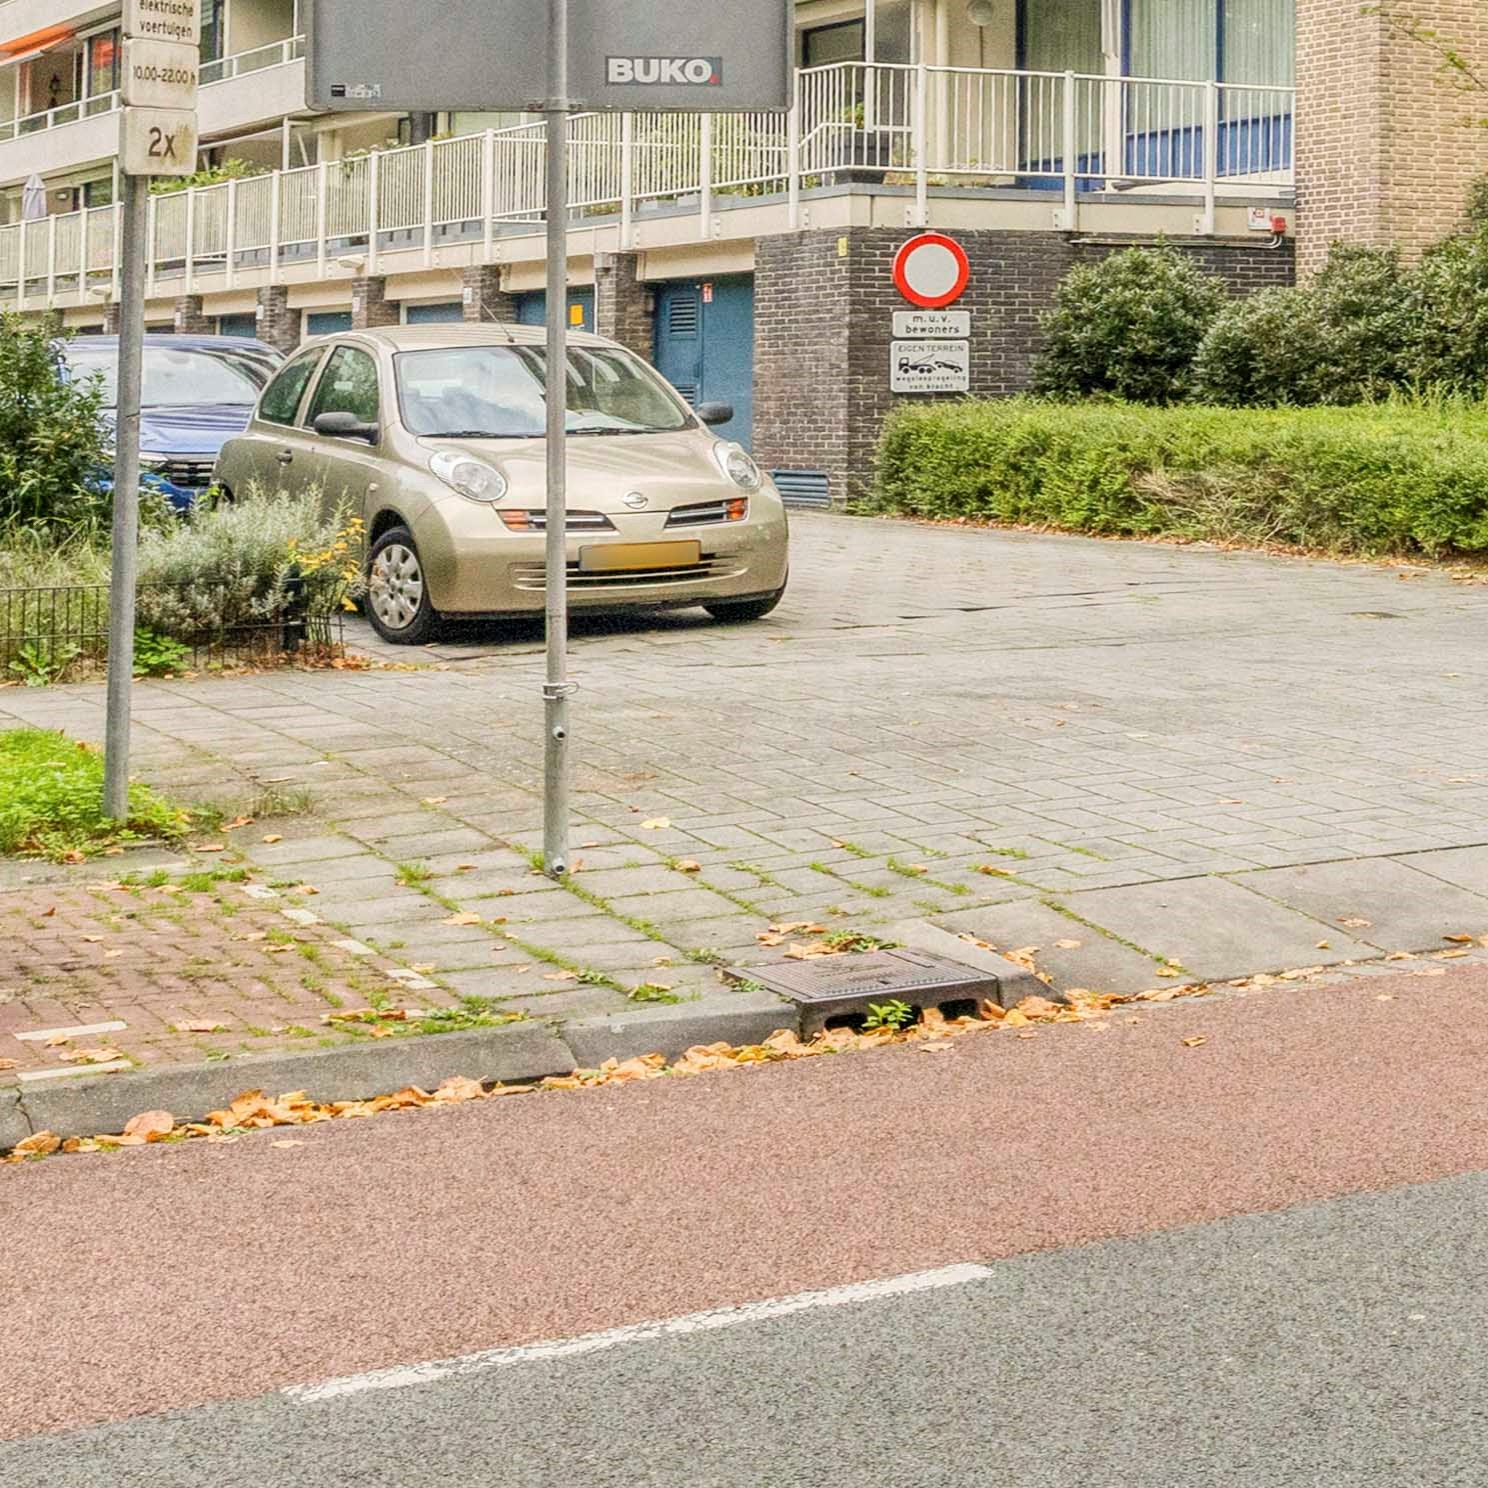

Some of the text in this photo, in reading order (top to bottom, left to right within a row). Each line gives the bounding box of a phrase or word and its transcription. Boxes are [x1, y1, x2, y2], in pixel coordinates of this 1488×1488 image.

[139, 20, 192, 40] voertuigen
[133, 65, 189, 84] 10.00-22.00
[148, 126, 176, 159] 2x
[912, 315, 951, 323] m.u.v.
[905, 325, 960, 334] bewoners
